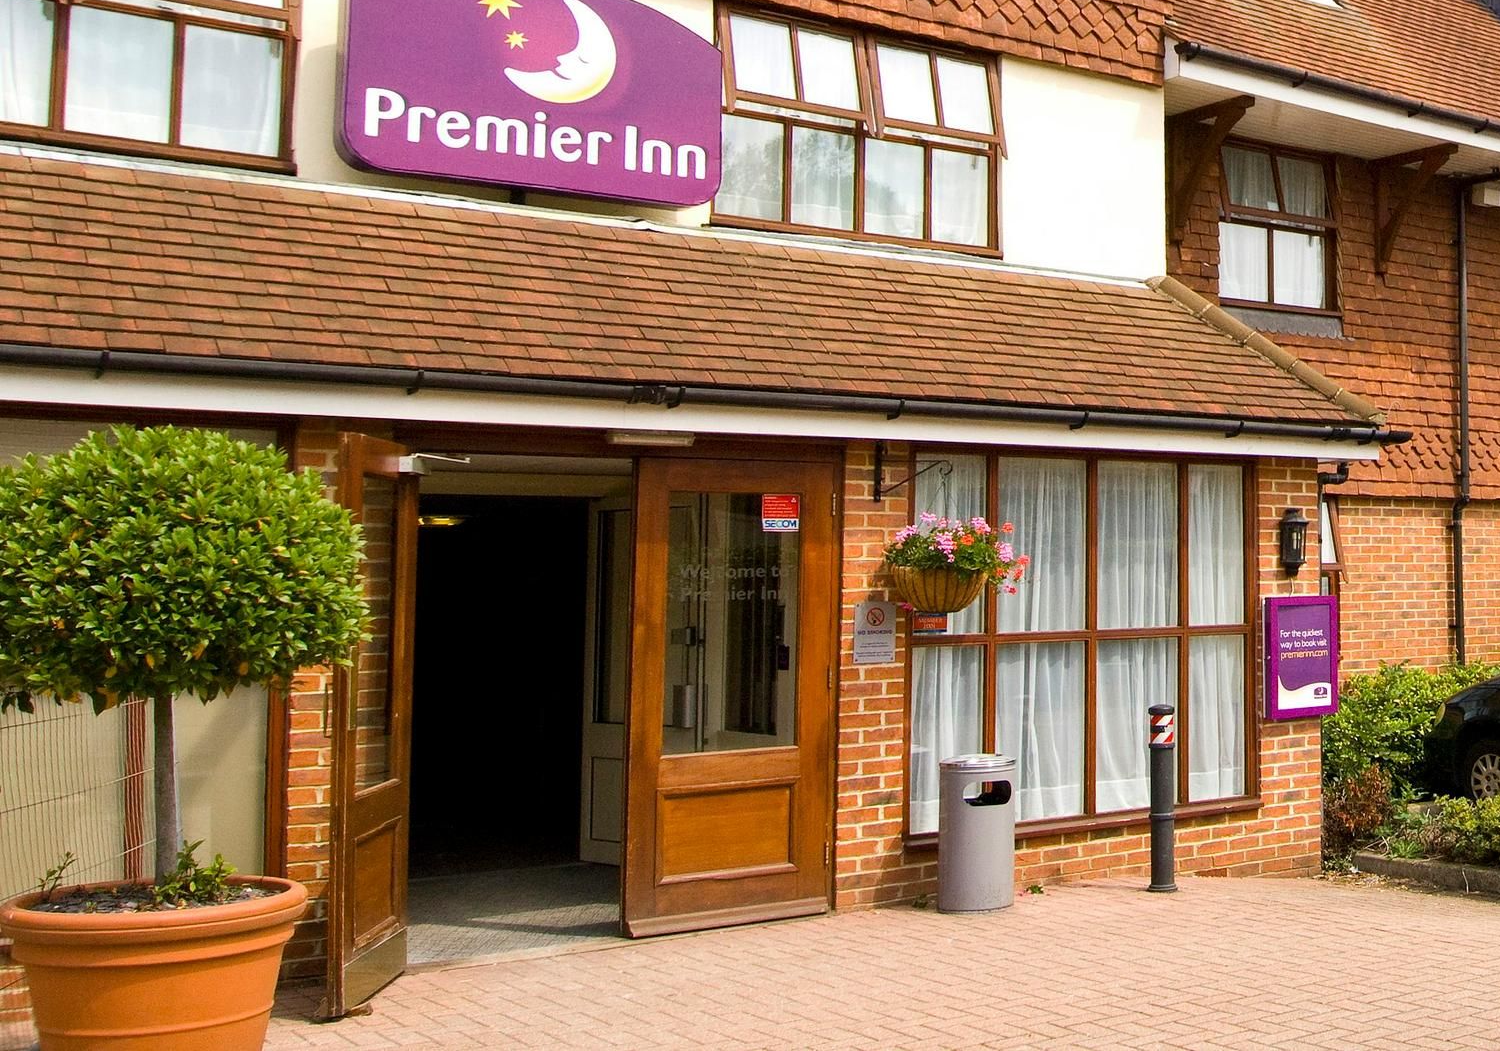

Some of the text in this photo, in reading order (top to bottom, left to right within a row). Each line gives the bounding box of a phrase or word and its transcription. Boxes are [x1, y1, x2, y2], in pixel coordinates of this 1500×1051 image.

[363, 87, 706, 180] Premier Inn
[765, 520, 797, 528] SECOM
[681, 564, 767, 579] Weome
[681, 586, 755, 601] Preier
[1280, 630, 1291, 638] For
[1291, 629, 1301, 638] the
[1280, 642, 1293, 650] way
[1294, 640, 1301, 648] to
[1301, 639, 1316, 648] book
